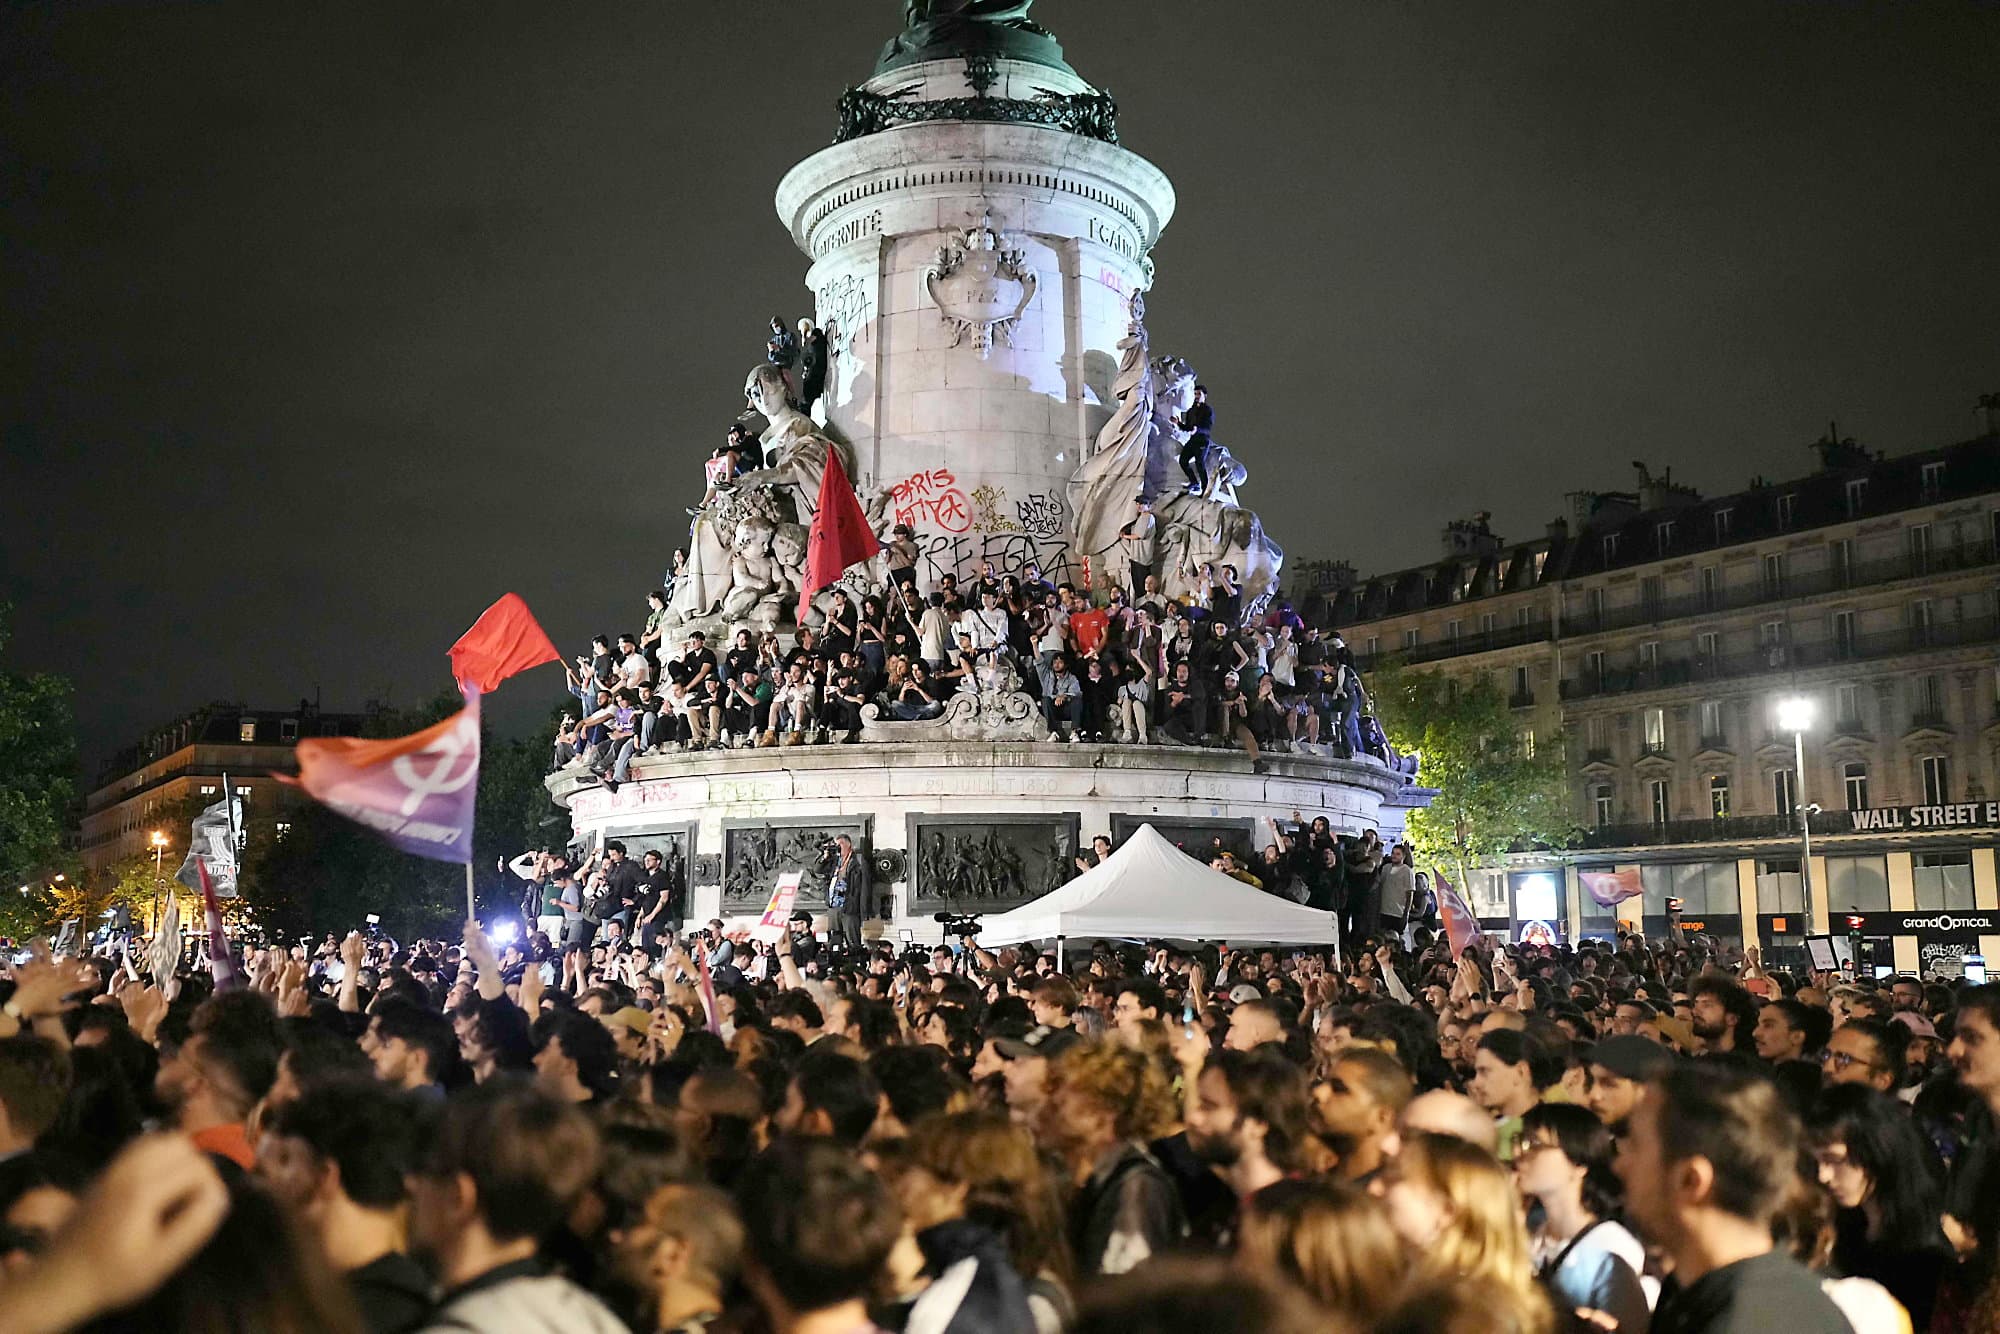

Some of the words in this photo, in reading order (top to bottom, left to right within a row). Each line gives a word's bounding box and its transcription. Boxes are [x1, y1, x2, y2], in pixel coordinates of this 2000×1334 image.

[889, 469, 955, 504] PARIS
[1001, 535, 1080, 586] GAZA
[1852, 808, 1903, 830] WALL
[1910, 804, 1979, 826] STREET
[1986, 802, 2000, 822] E
